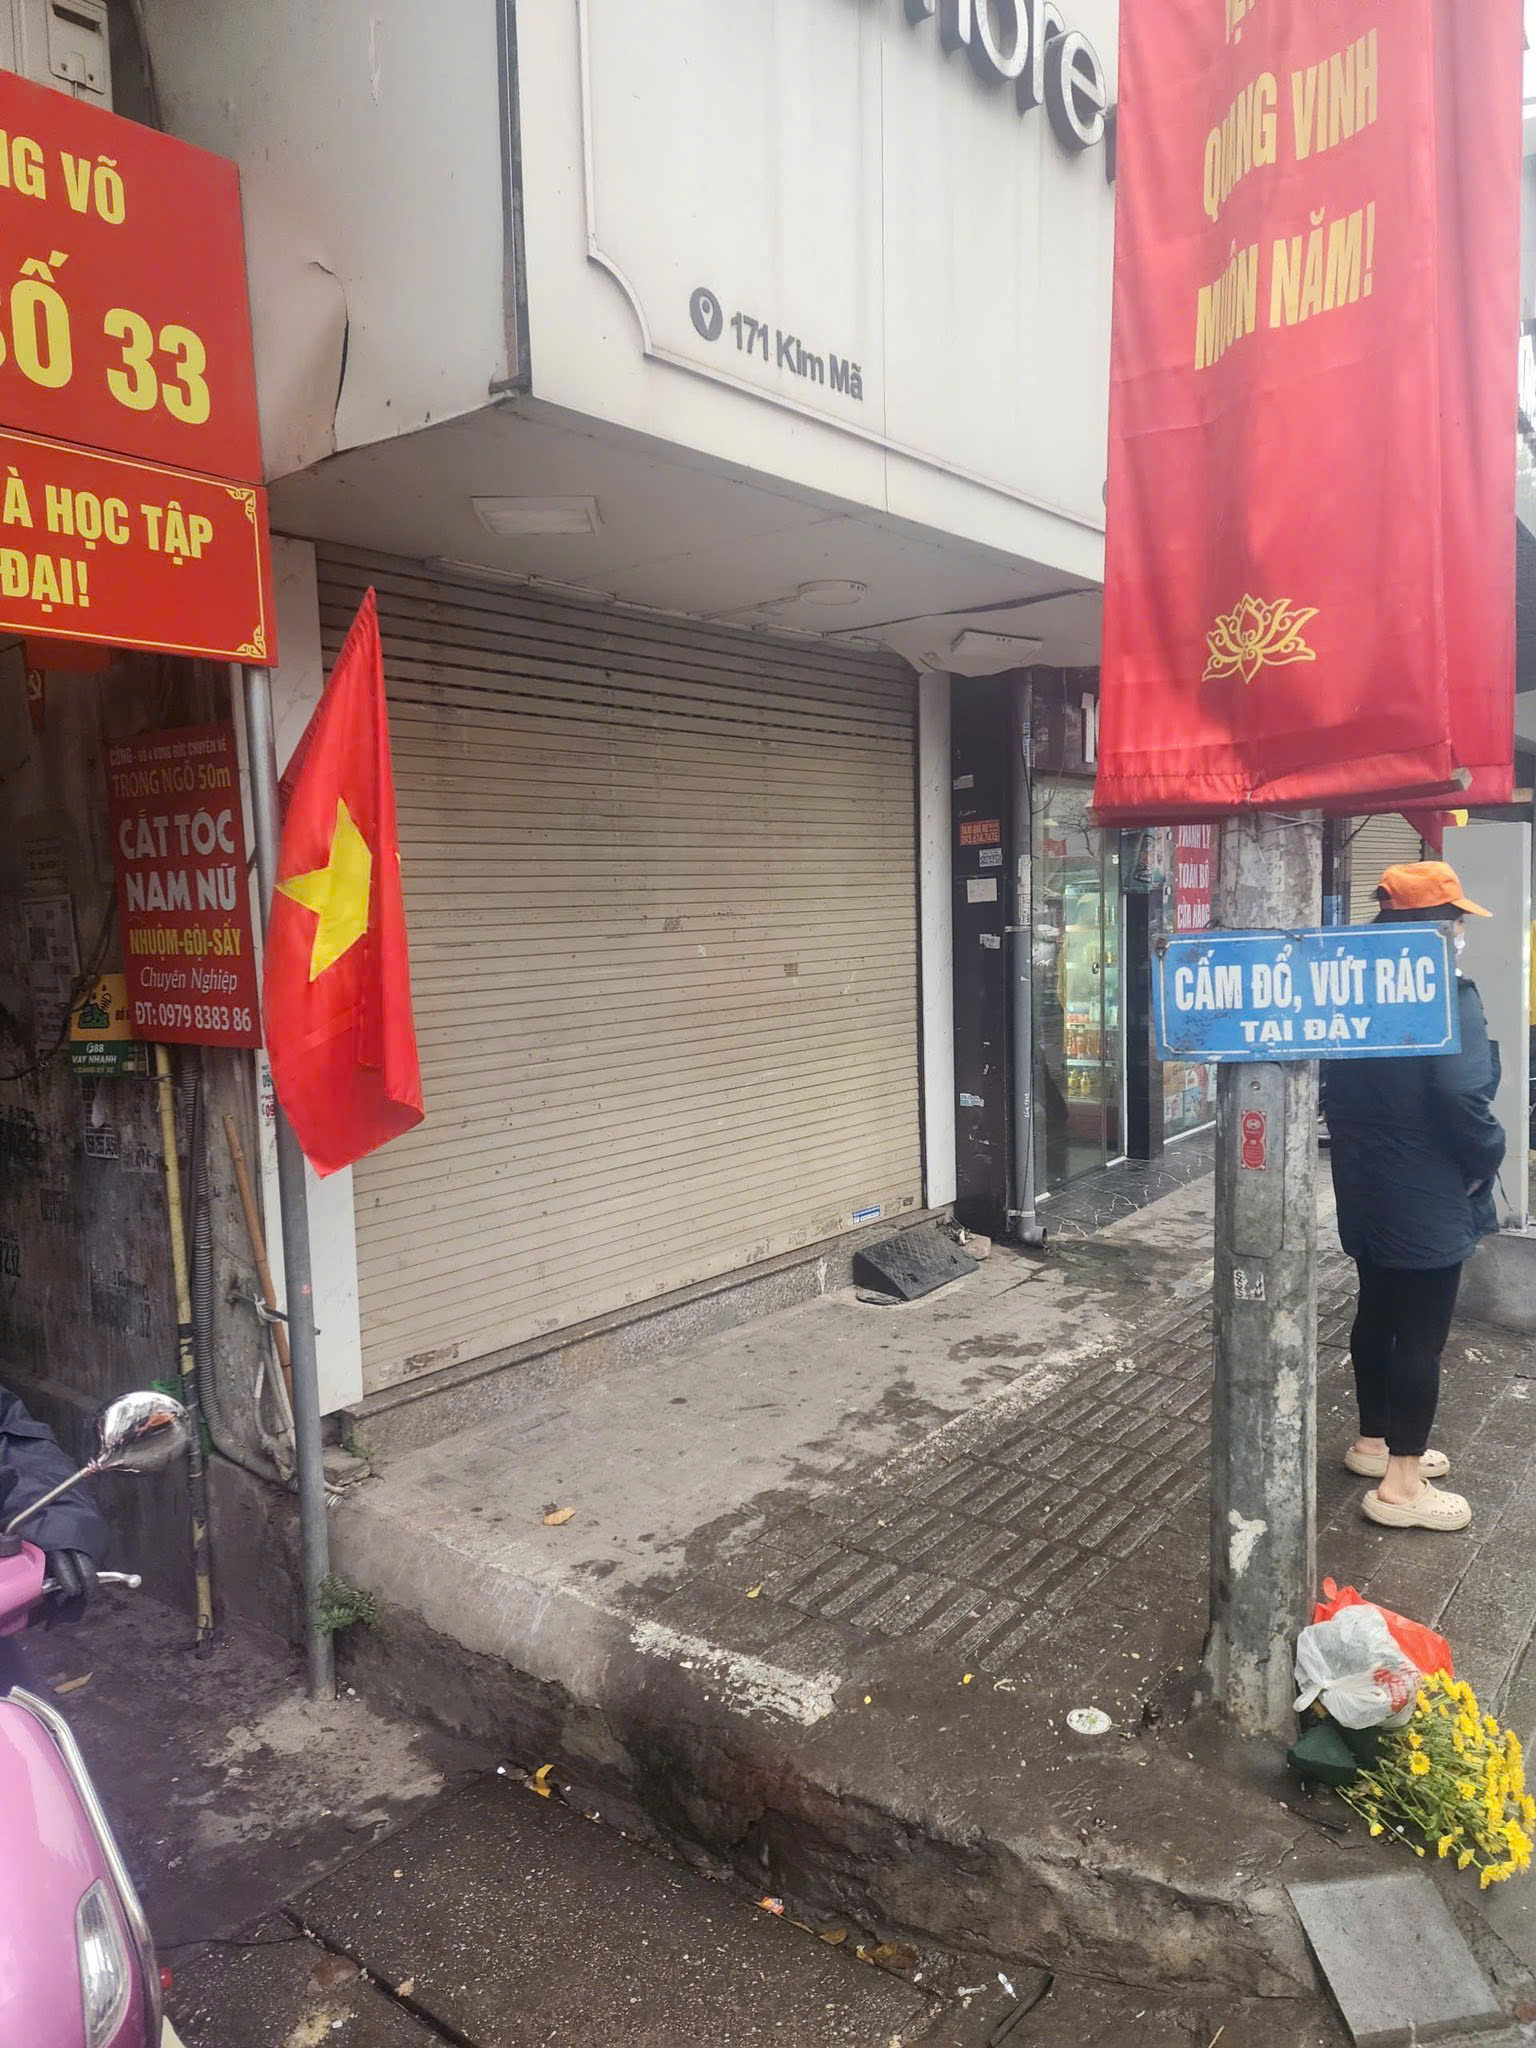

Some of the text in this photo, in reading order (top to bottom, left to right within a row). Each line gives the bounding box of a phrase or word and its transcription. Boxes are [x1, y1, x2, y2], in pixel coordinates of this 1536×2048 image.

[1291, 27, 1378, 161] VINH
[60, 151, 126, 225] VÕ
[1269, 200, 1376, 328] NĂM!
[0, 250, 211, 425] Ố 33
[731, 311, 864, 401] 171 Kim Mã
[45, 484, 131, 550] HỌC
[140, 500, 214, 565] TẬP
[0, 546, 90, 613] ĐẠI!
[112, 769, 160, 798] TRONG
[199, 763, 232, 789] 50m
[119, 807, 235, 860] CẮT TÓC
[125, 862, 237, 912] NAM NỮ
[140, 966, 238, 994] Chuyên Nghiệp
[1175, 944, 1436, 1013] CẤM ĐỔ, VỨT RÁC
[135, 1001, 157, 1025] ĐT:
[159, 1003, 191, 1028] 0979
[194, 1005, 229, 1030] 8383
[233, 1007, 251, 1032] 86
[1240, 1013, 1371, 1046] TẠI ĐÂY
[72, 1055, 117, 1064] VAY NHANH
